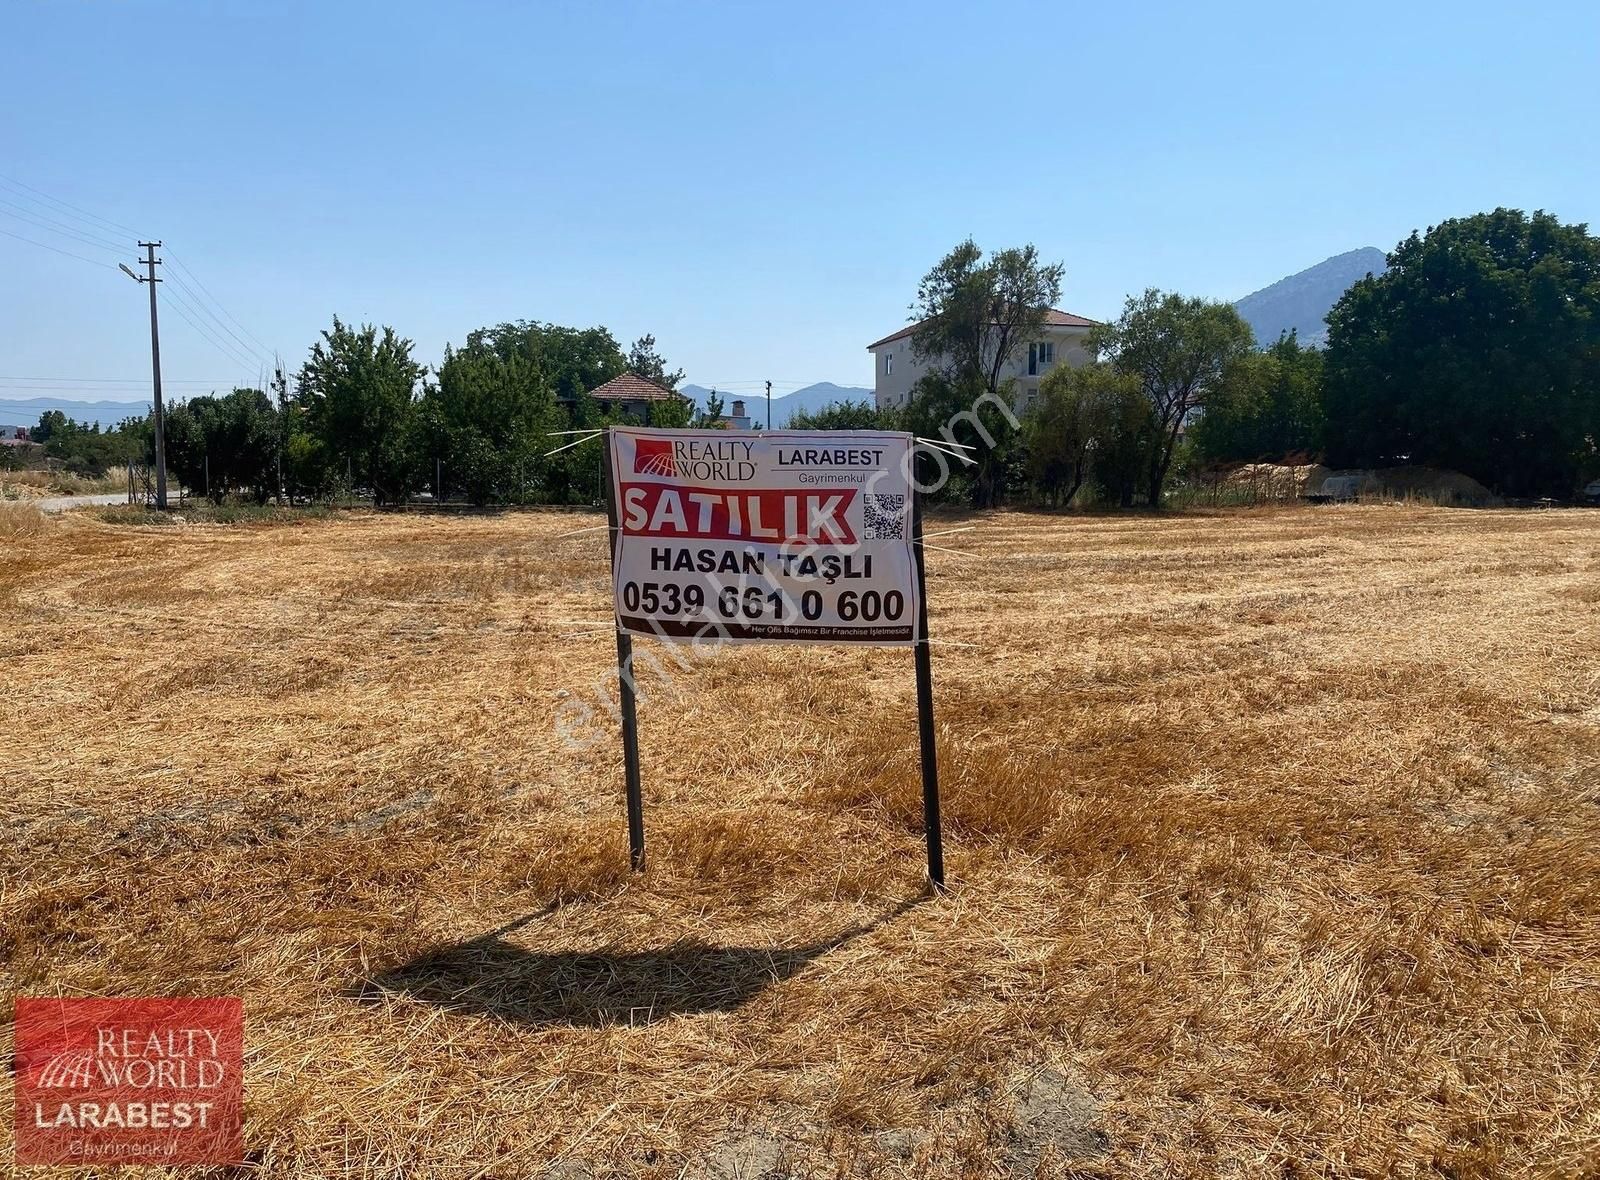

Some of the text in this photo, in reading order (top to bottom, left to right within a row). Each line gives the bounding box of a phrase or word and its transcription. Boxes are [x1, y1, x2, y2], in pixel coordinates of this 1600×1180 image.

[675, 440, 755, 462] REALTY
[778, 449, 884, 466] LARABEST
[675, 462, 756, 481] WORLD
[798, 473, 866, 485] Gayrimenkul
[624, 487, 848, 539] SATILIK
[650, 547, 872, 585] HASAN TAŞLI
[623, 581, 905, 622] 0539 661 0 600
[751, 625, 766, 634] Her
[767, 626, 782, 634] Ofis
[820, 627, 830, 635] Bir
[832, 627, 868, 636] Franchise
